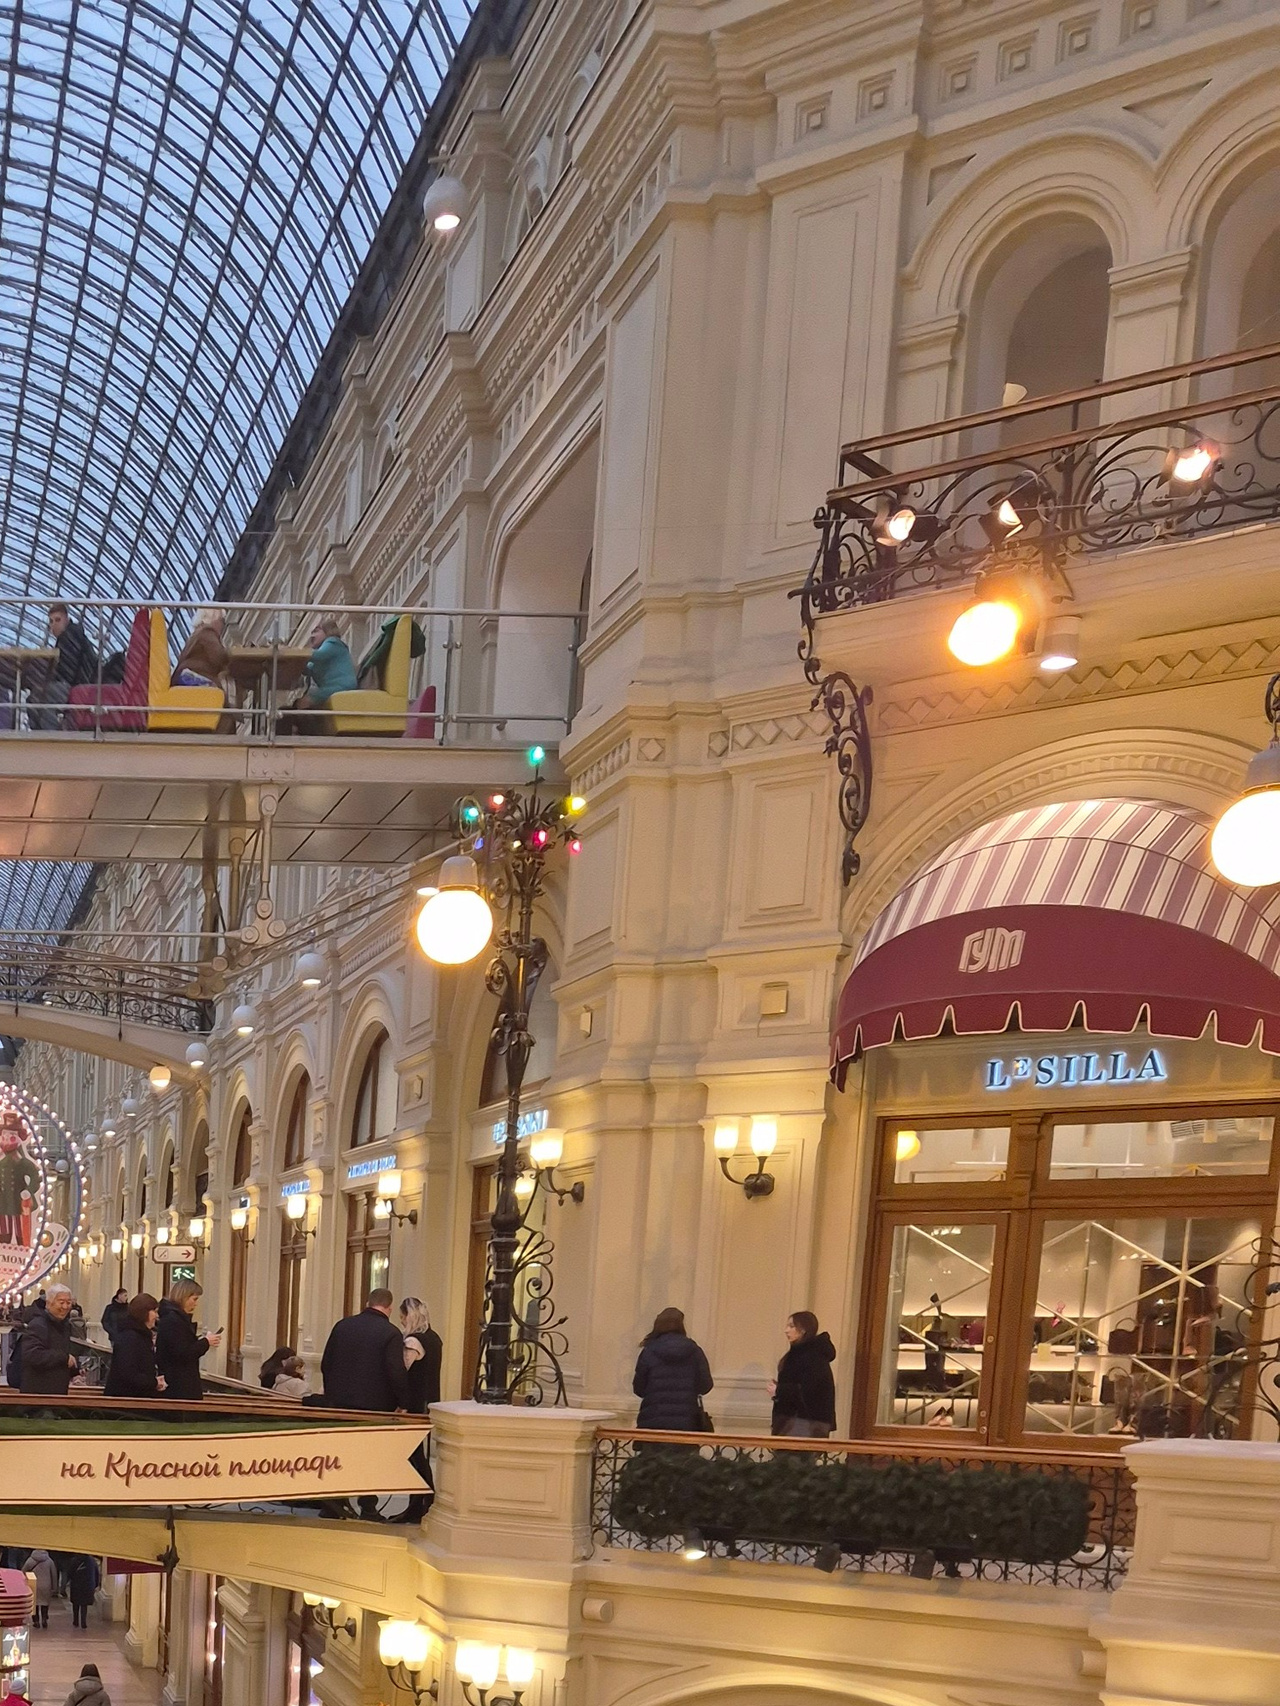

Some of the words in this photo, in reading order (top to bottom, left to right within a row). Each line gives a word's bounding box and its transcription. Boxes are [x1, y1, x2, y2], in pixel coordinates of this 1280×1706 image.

[958, 927, 1027, 974] ГУМ
[1034, 1048, 1168, 1088] SILLA
[60, 1461, 95, 1478] на
[104, 1451, 221, 1488] Красной
[228, 1454, 342, 1480] площади
